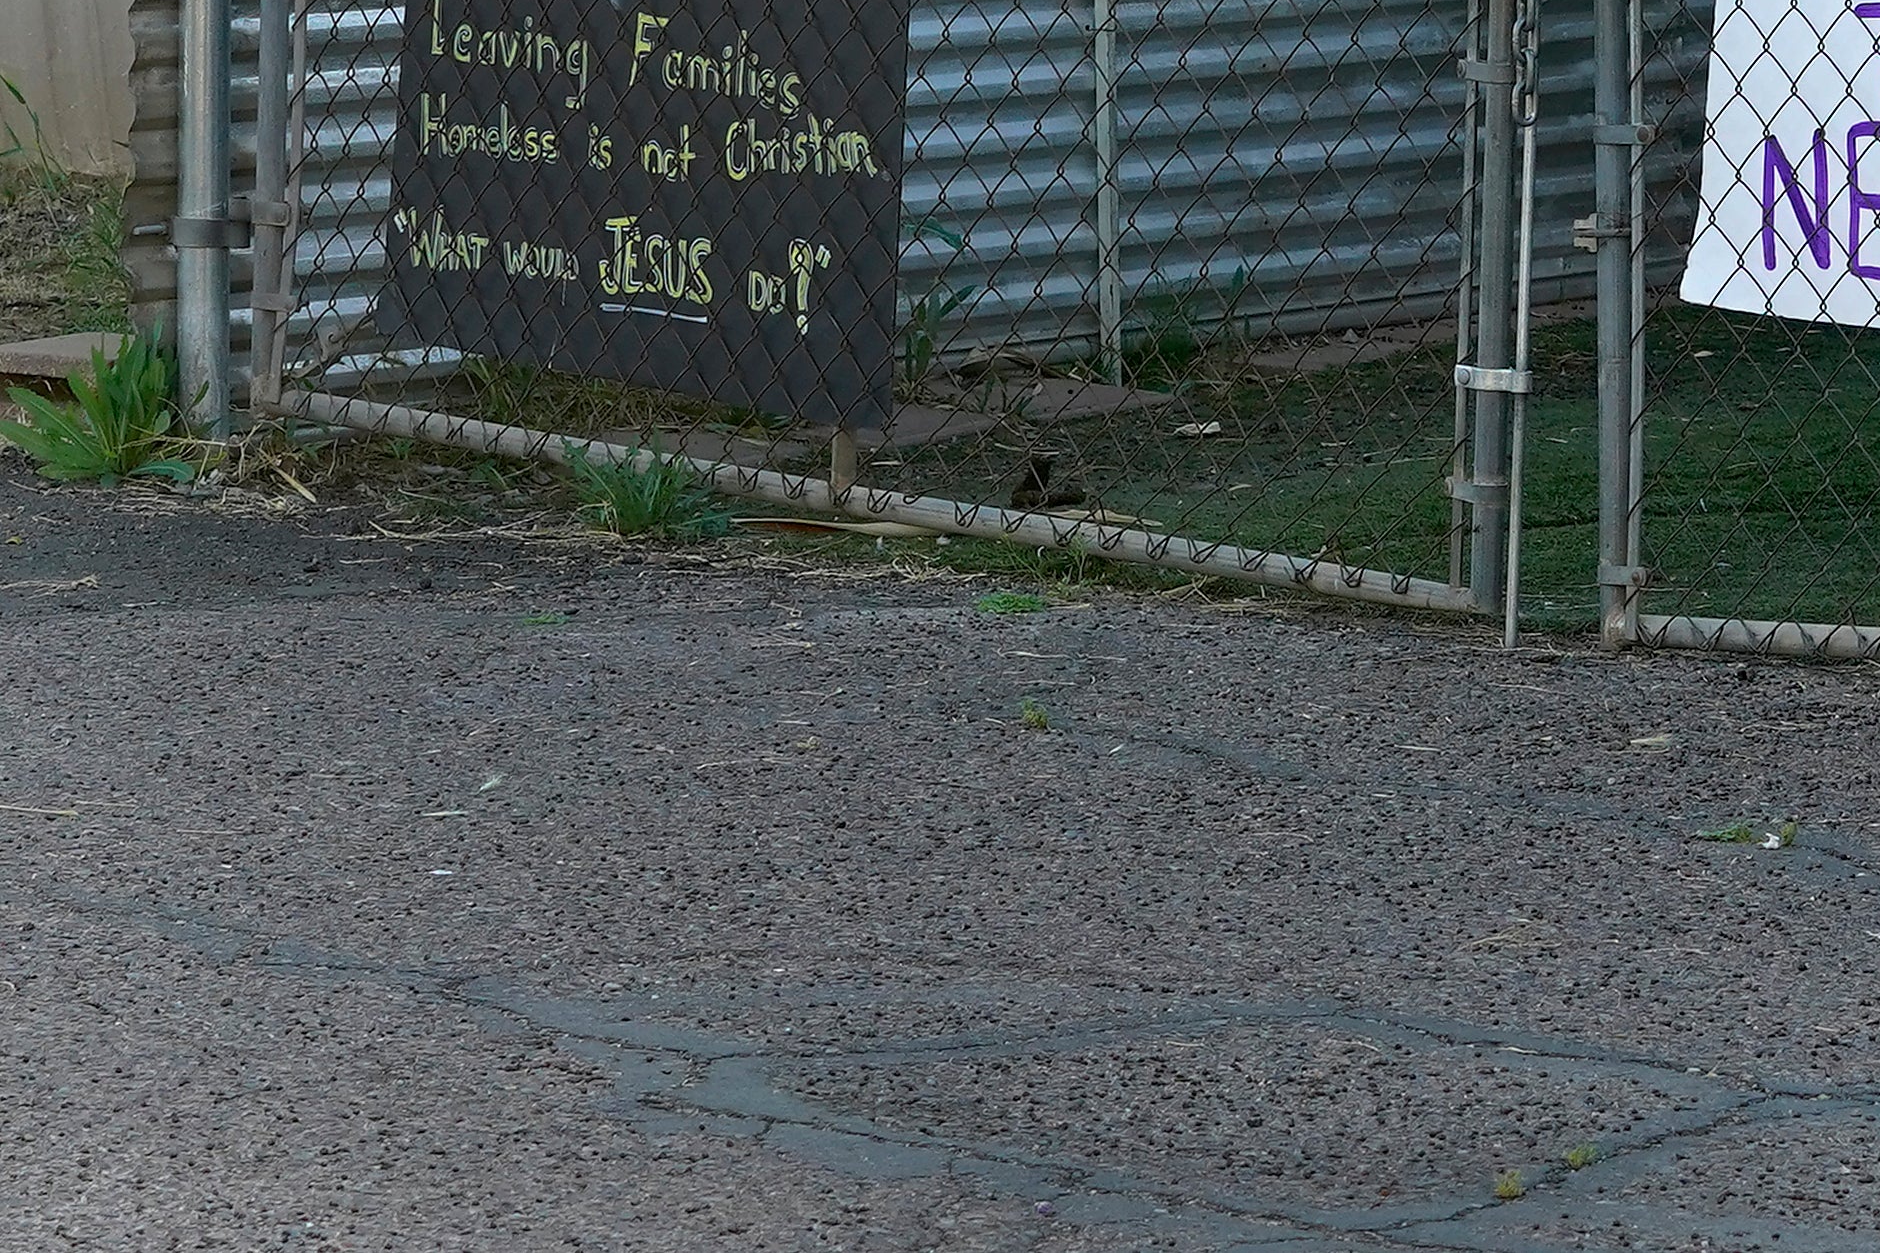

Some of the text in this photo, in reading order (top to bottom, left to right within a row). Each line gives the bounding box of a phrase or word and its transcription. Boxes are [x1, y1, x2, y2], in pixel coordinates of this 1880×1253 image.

[628, 11, 801, 120] Families
[419, 92, 561, 165] Homeless
[588, 121, 614, 171] is
[639, 123, 697, 183] not
[598, 215, 714, 305] JESUS
